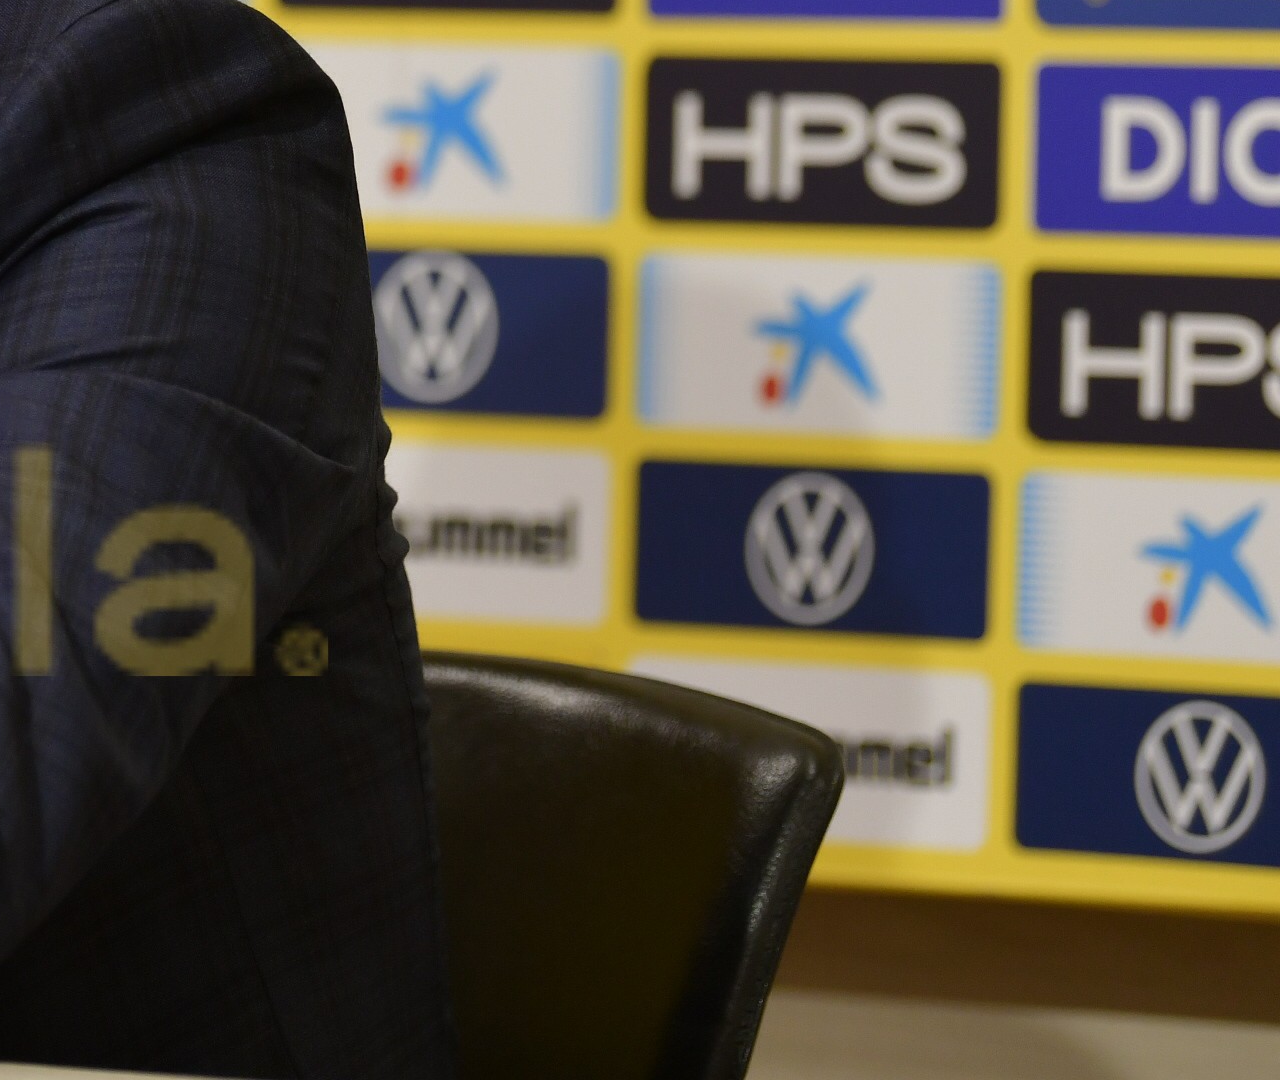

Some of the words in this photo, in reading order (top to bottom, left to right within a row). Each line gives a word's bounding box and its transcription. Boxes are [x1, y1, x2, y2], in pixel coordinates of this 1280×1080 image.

[670, 91, 968, 205] HPS
[1060, 308, 1280, 420] HP
[392, 502, 579, 562] ummel
